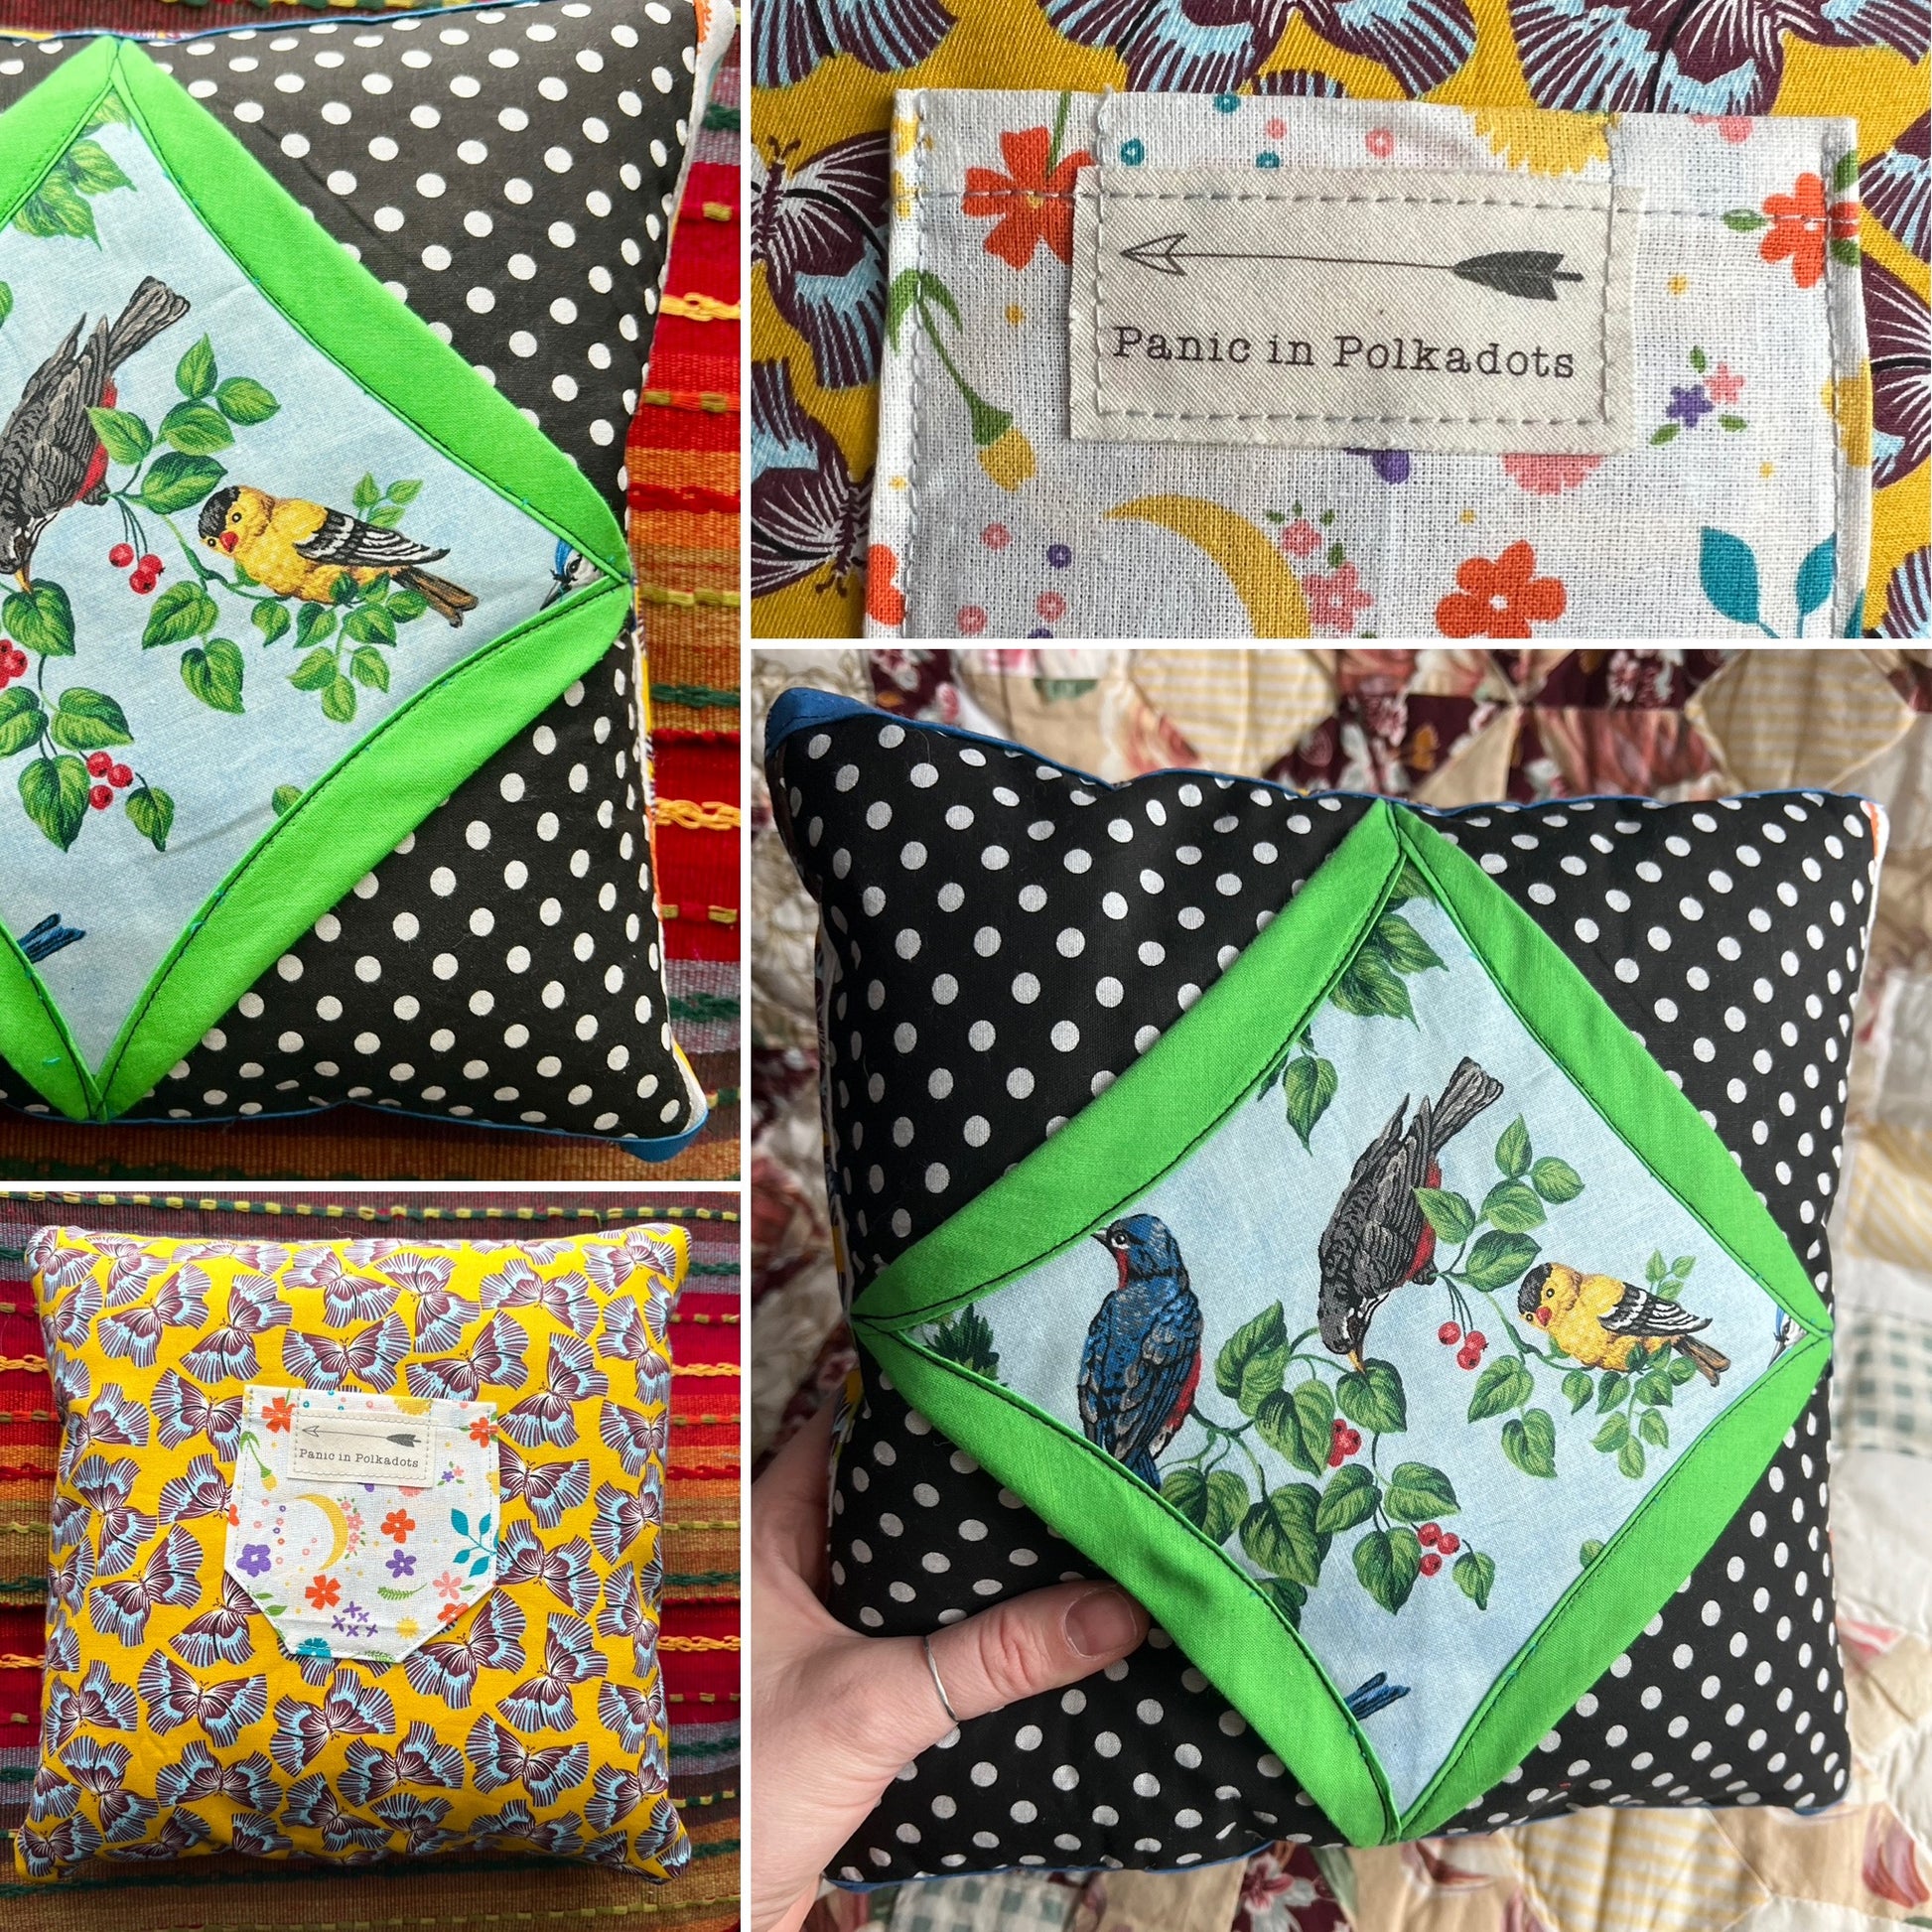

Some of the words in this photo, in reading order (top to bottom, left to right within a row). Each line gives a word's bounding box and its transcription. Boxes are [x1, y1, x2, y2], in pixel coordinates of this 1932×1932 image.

[1112, 326, 1251, 364] Panic
[1267, 335, 1315, 366] in
[1332, 334, 1576, 378] Polkadots
[299, 1449, 335, 1460] Panic
[339, 1451, 351, 1462] in
[355, 1452, 419, 1468] Polkadots
